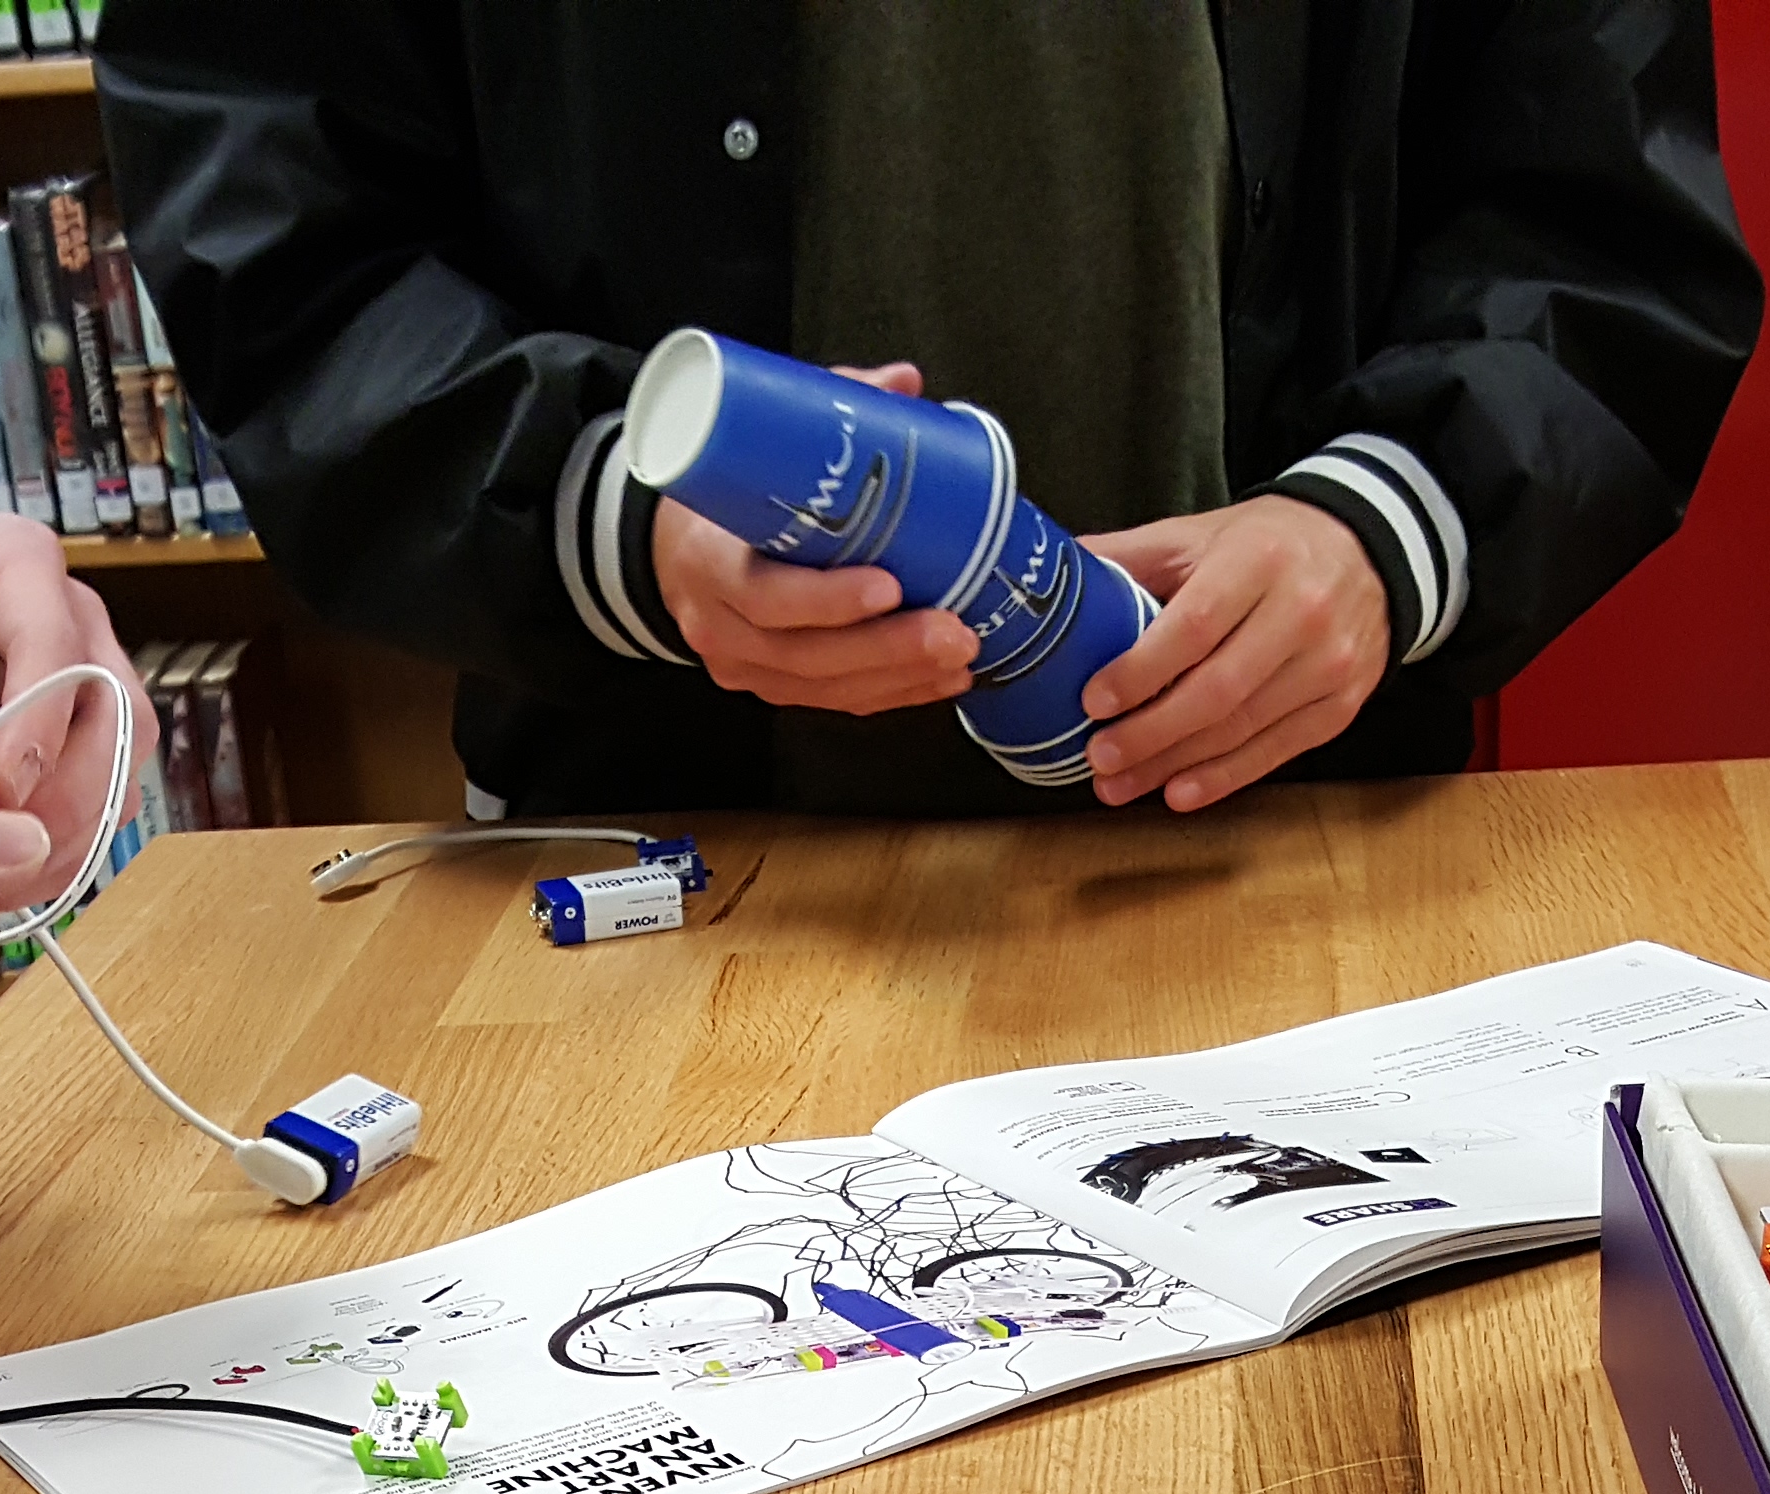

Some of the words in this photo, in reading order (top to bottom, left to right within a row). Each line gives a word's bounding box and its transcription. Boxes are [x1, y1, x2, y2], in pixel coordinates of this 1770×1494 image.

[583, 872, 673, 890] littleBits
[615, 914, 659, 931] POWER
[334, 1092, 410, 1131] littleBits
[1313, 1201, 1414, 1224] SHARE
[578, 1431, 631, 1449] CREATING
[486, 1425, 700, 1494] MACHINE
[526, 1451, 566, 1466] DOODLE
[648, 1438, 716, 1467] AN
[471, 1462, 518, 1480] WIZARD
[559, 1461, 640, 1494] ART
